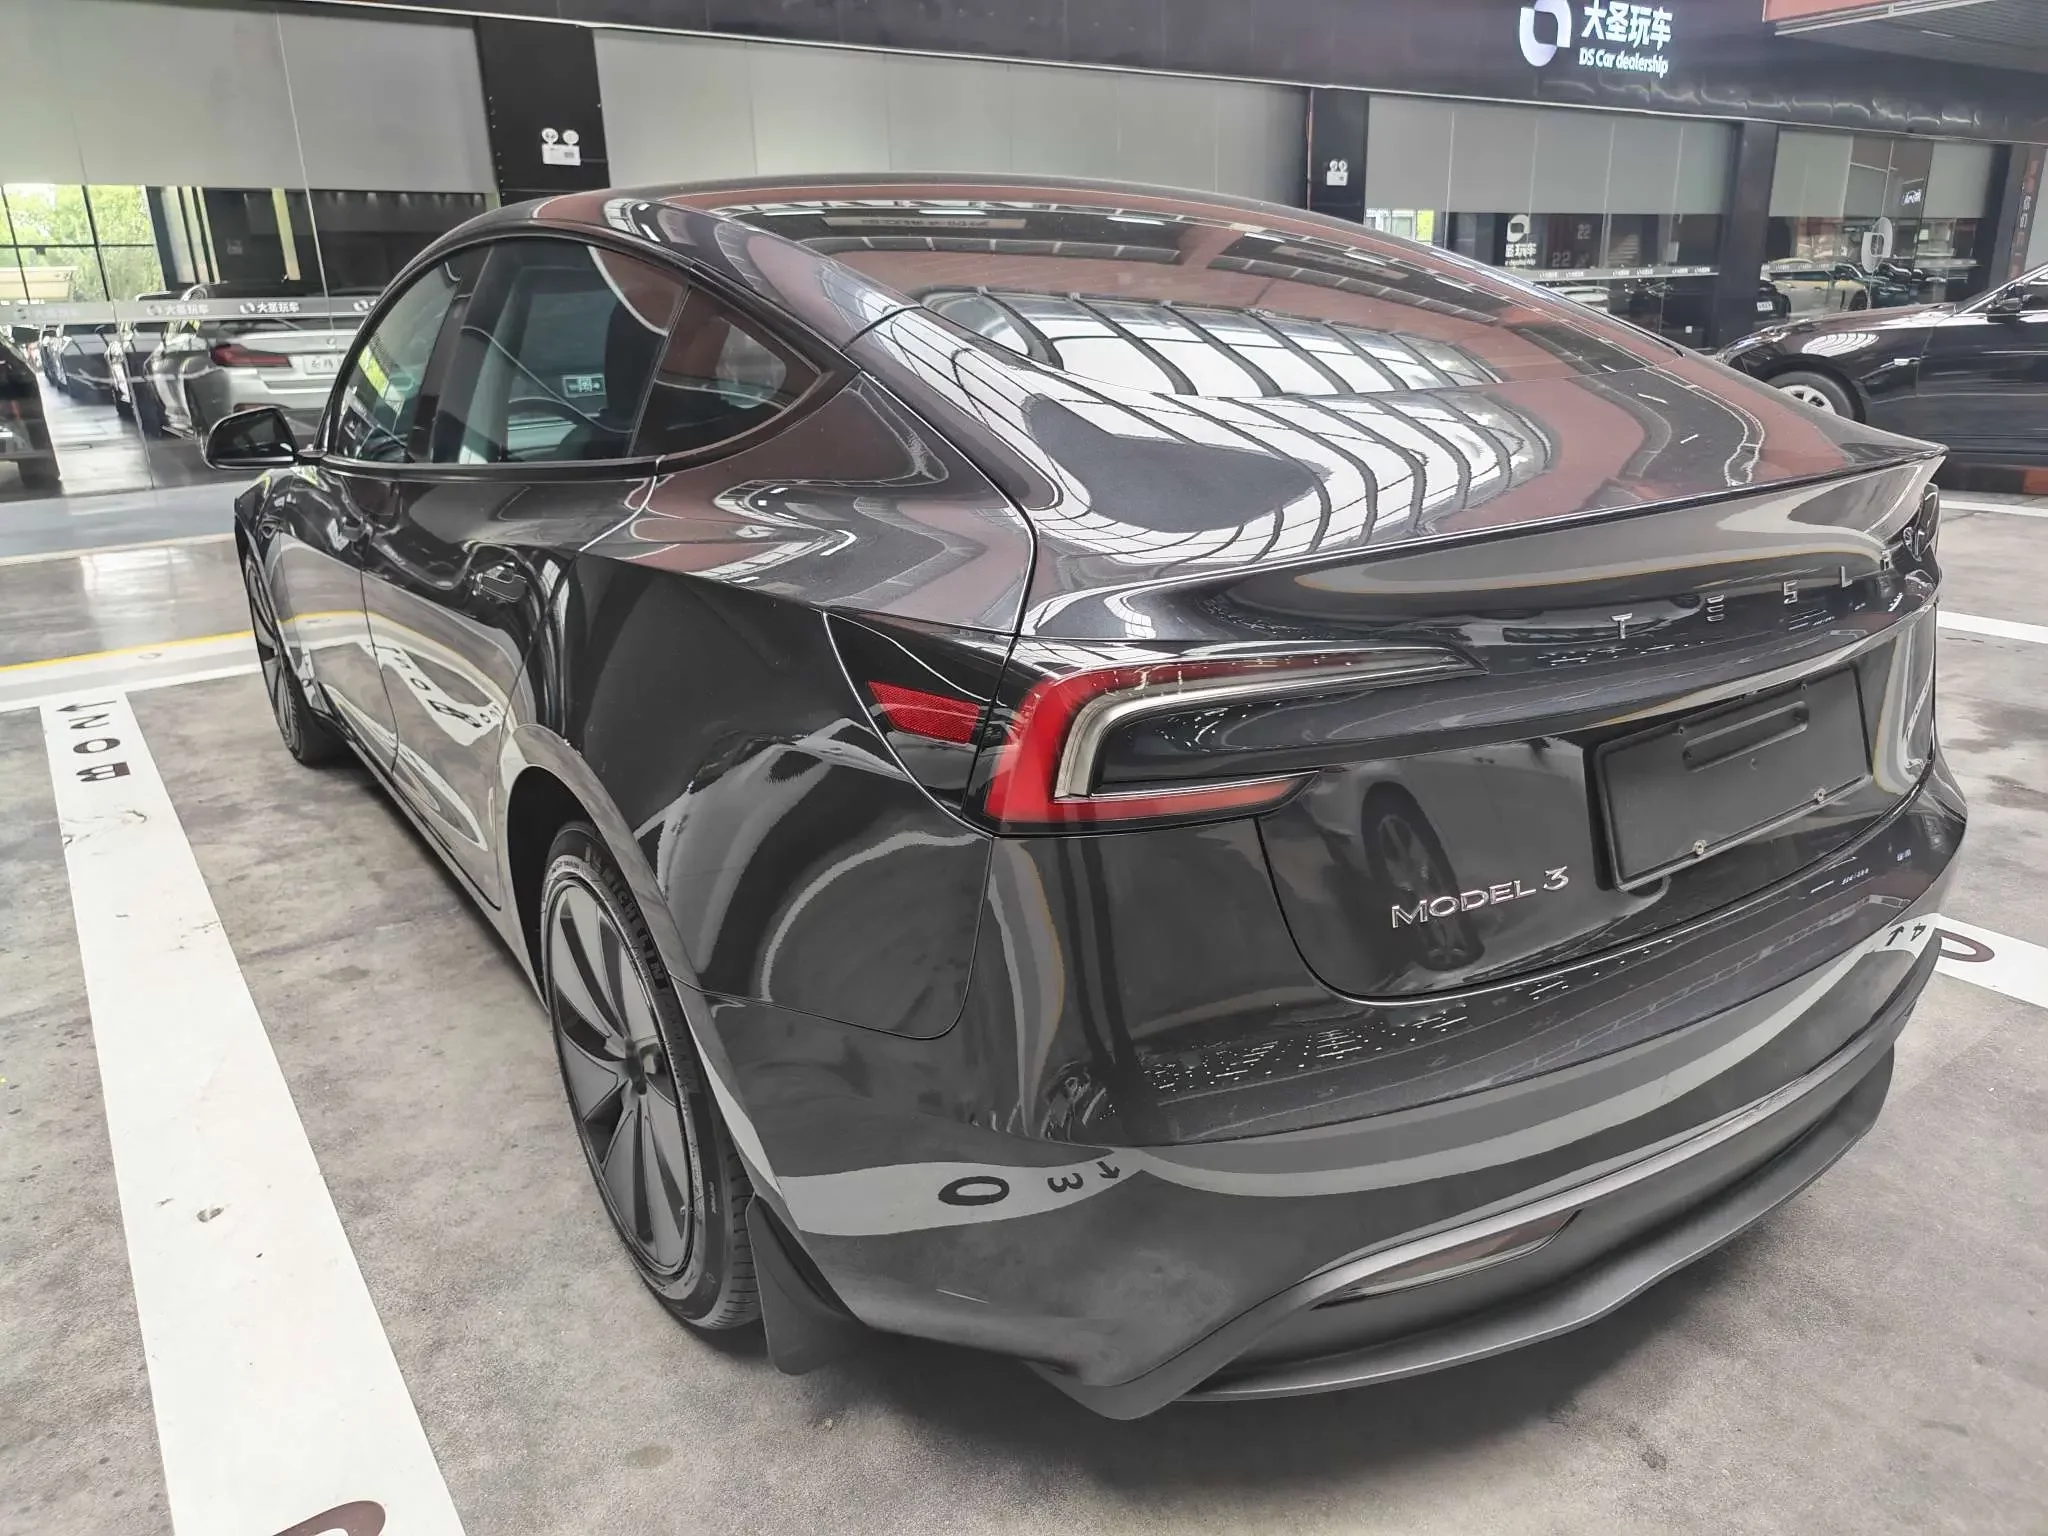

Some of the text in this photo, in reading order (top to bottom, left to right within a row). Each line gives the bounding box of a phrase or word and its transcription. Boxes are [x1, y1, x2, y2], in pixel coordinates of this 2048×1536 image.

[1581, 0, 1673, 51] 大圣玩车
[1579, 47, 1669, 78] DS Car dealership
[1391, 865, 1569, 929] MODEL 3
